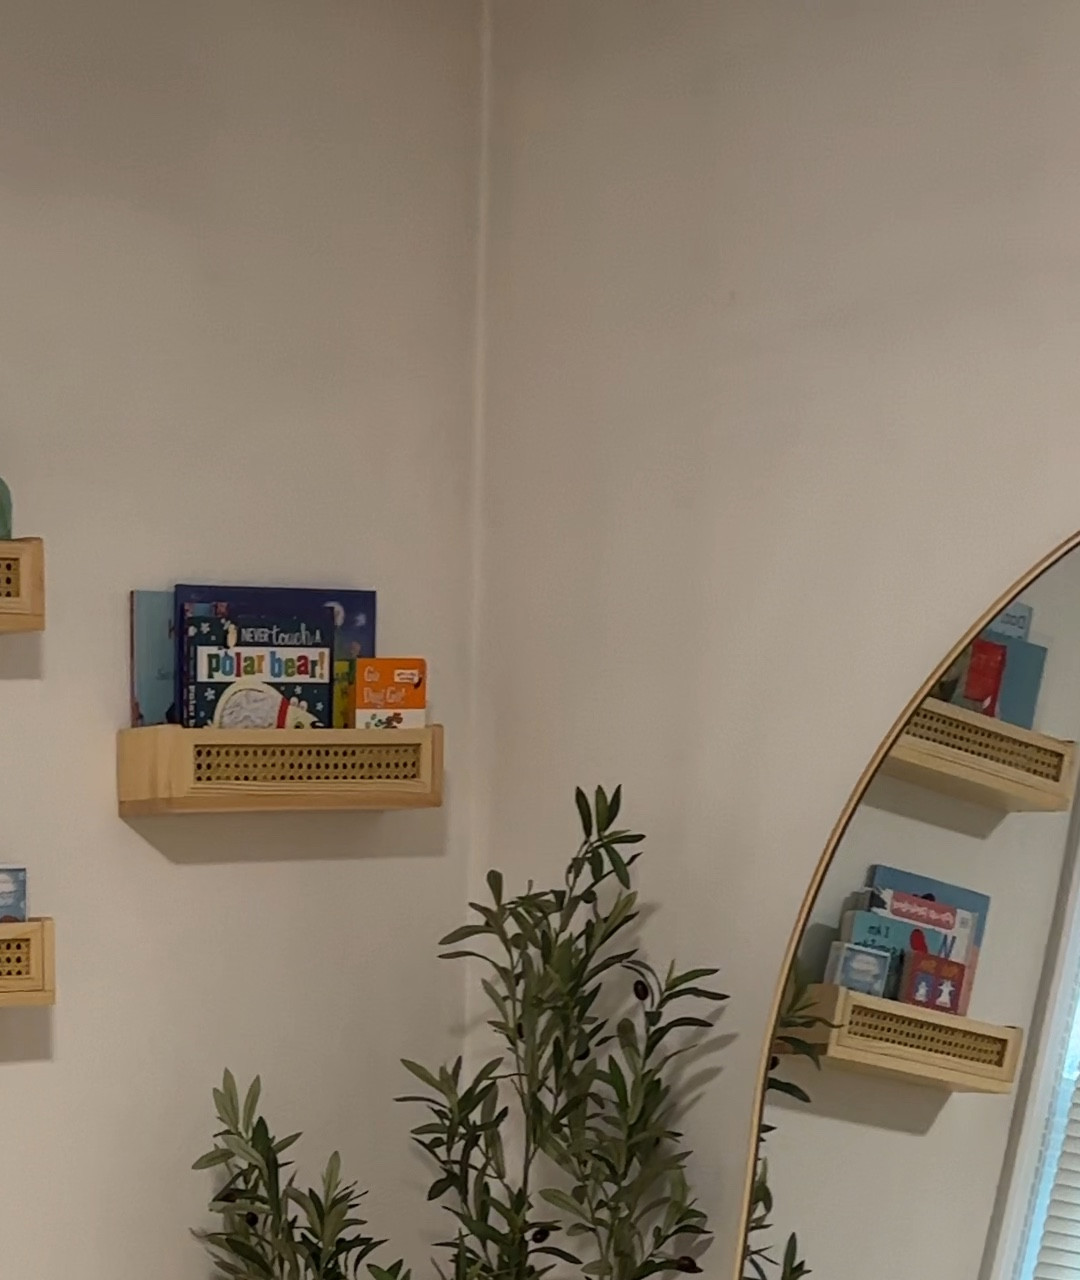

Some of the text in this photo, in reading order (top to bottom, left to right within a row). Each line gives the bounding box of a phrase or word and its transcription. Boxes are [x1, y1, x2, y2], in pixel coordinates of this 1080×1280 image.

[270, 622, 313, 646] touch
[207, 651, 265, 679] polar
[270, 651, 326, 680] bear!
